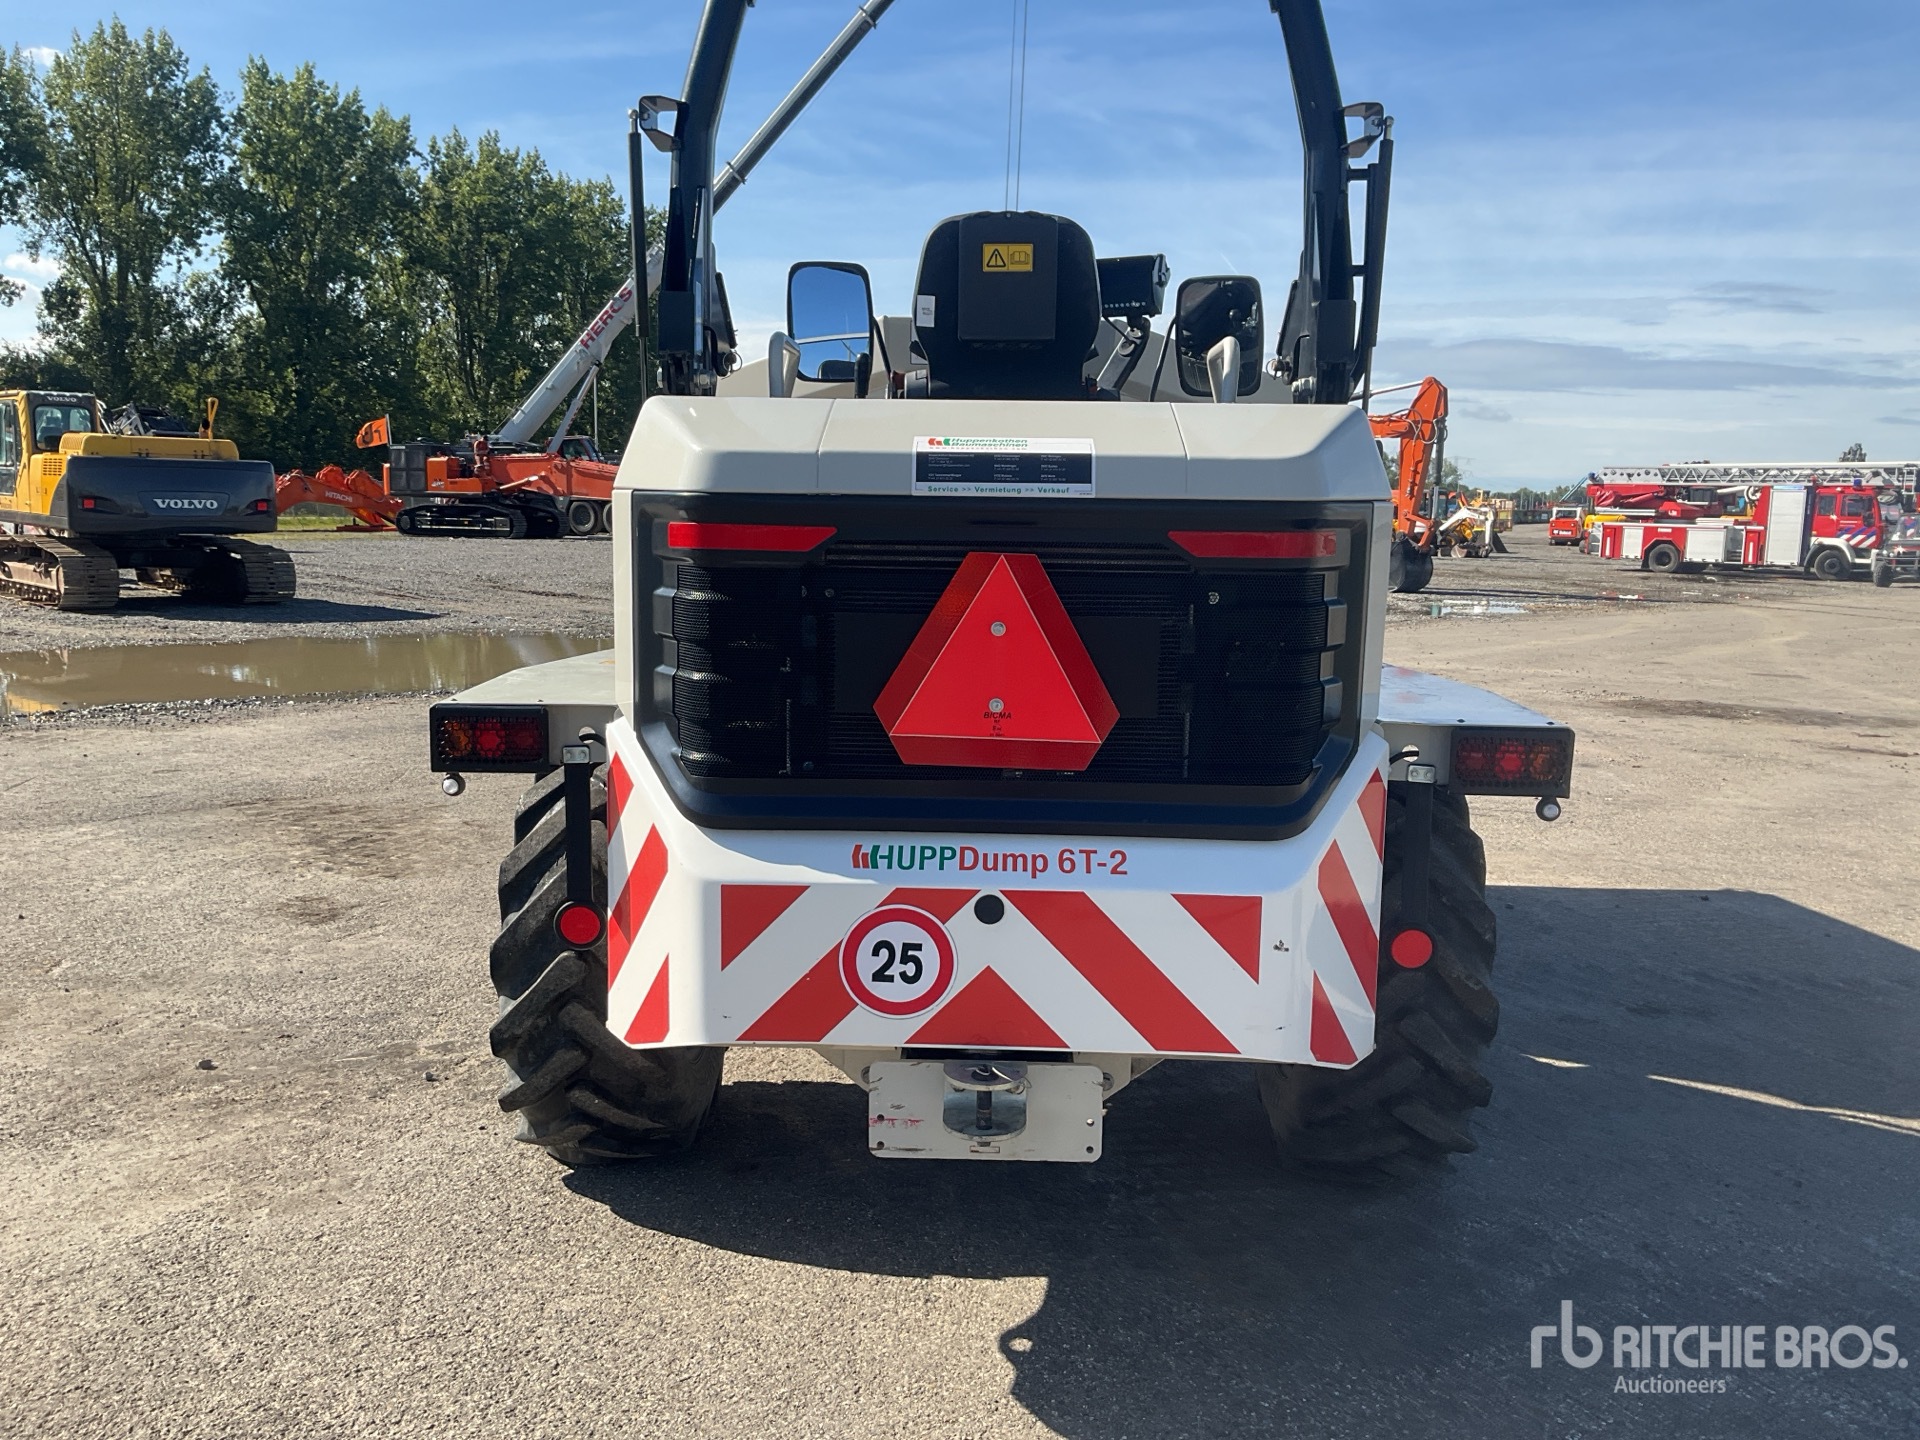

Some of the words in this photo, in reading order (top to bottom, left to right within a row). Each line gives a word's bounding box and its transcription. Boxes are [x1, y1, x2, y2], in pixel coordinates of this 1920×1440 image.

[47, 395, 77, 403] VOLVO
[975, 486, 1022, 494] Vermietung
[325, 490, 353, 503] HITACHI
[153, 498, 219, 510] VOLVO
[983, 711, 1012, 719] BICMA
[1057, 848, 1128, 875] 6T-2
[871, 940, 924, 985] 25
